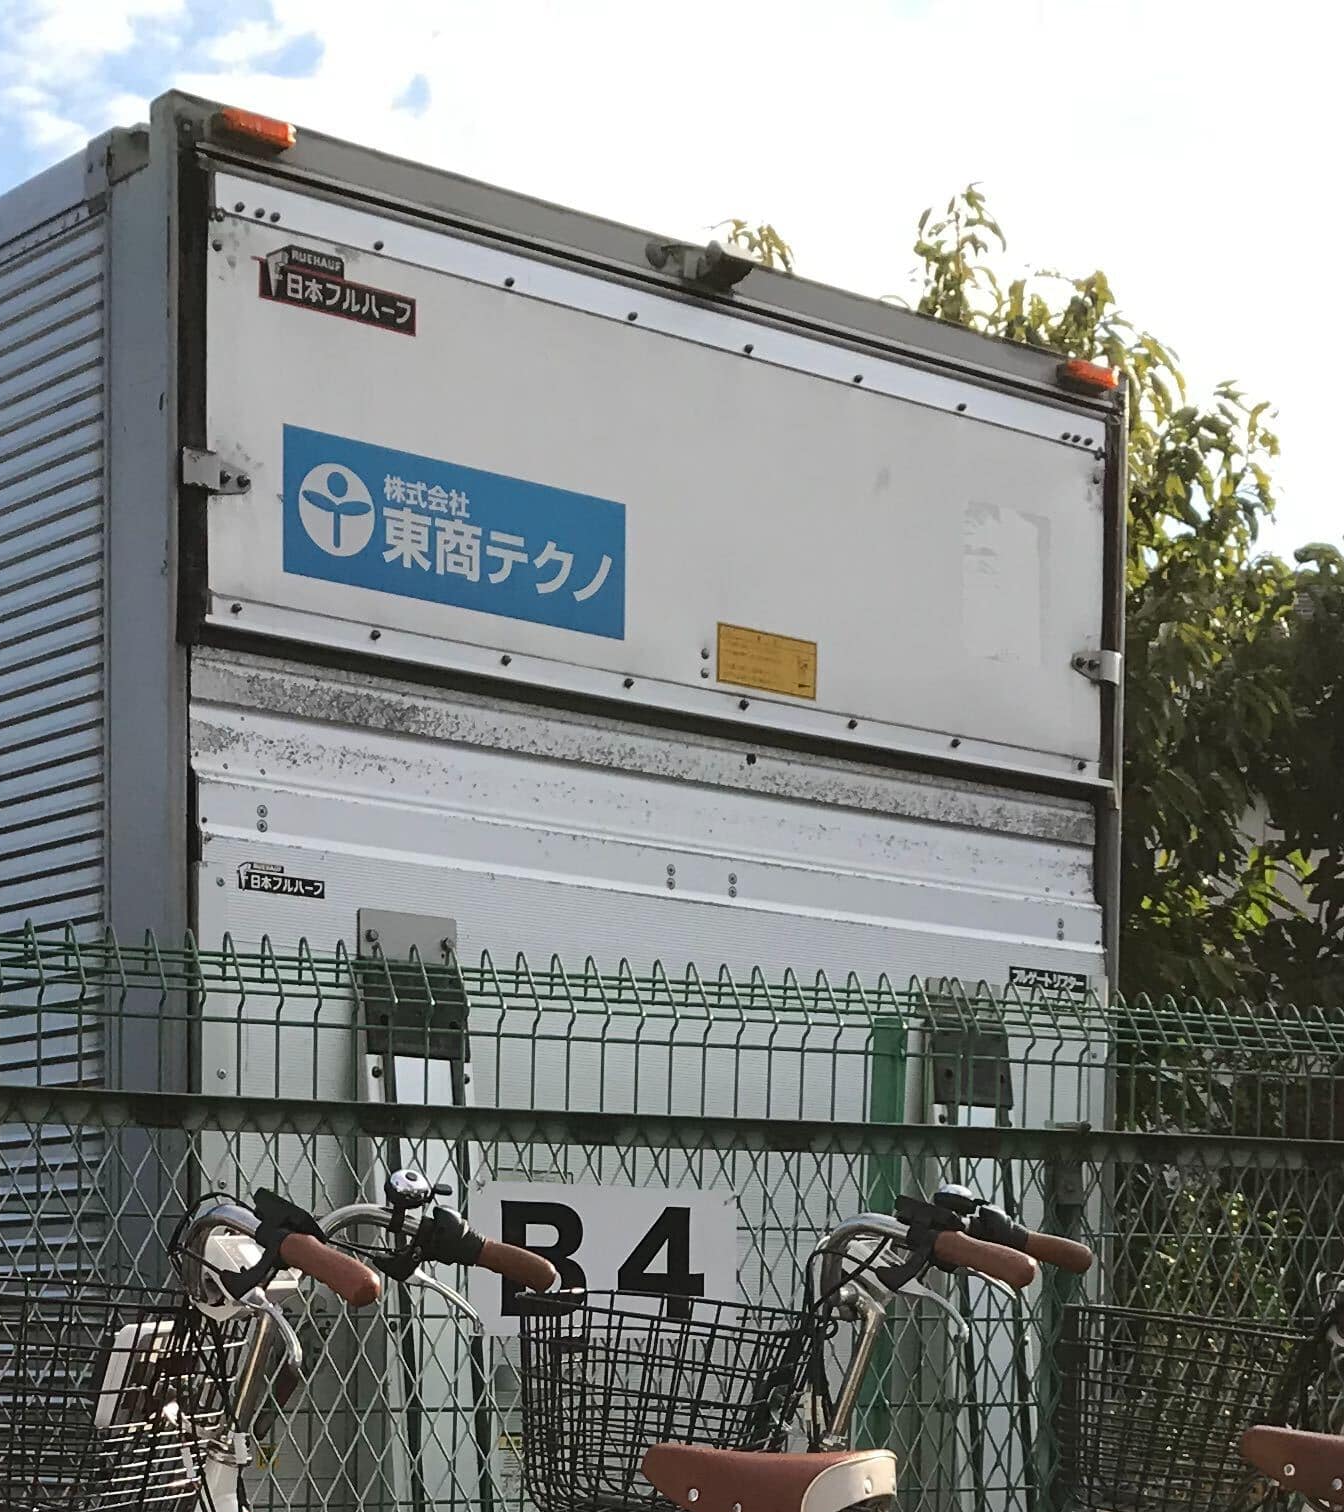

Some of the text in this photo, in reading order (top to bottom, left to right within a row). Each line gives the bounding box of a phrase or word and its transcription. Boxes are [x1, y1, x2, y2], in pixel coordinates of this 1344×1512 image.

[286, 272, 412, 324] 日本フルハーフ
[383, 473, 471, 518] 株式会社
[382, 507, 613, 602] 東商テクノ
[250, 874, 324, 895] 日本フルハーフ
